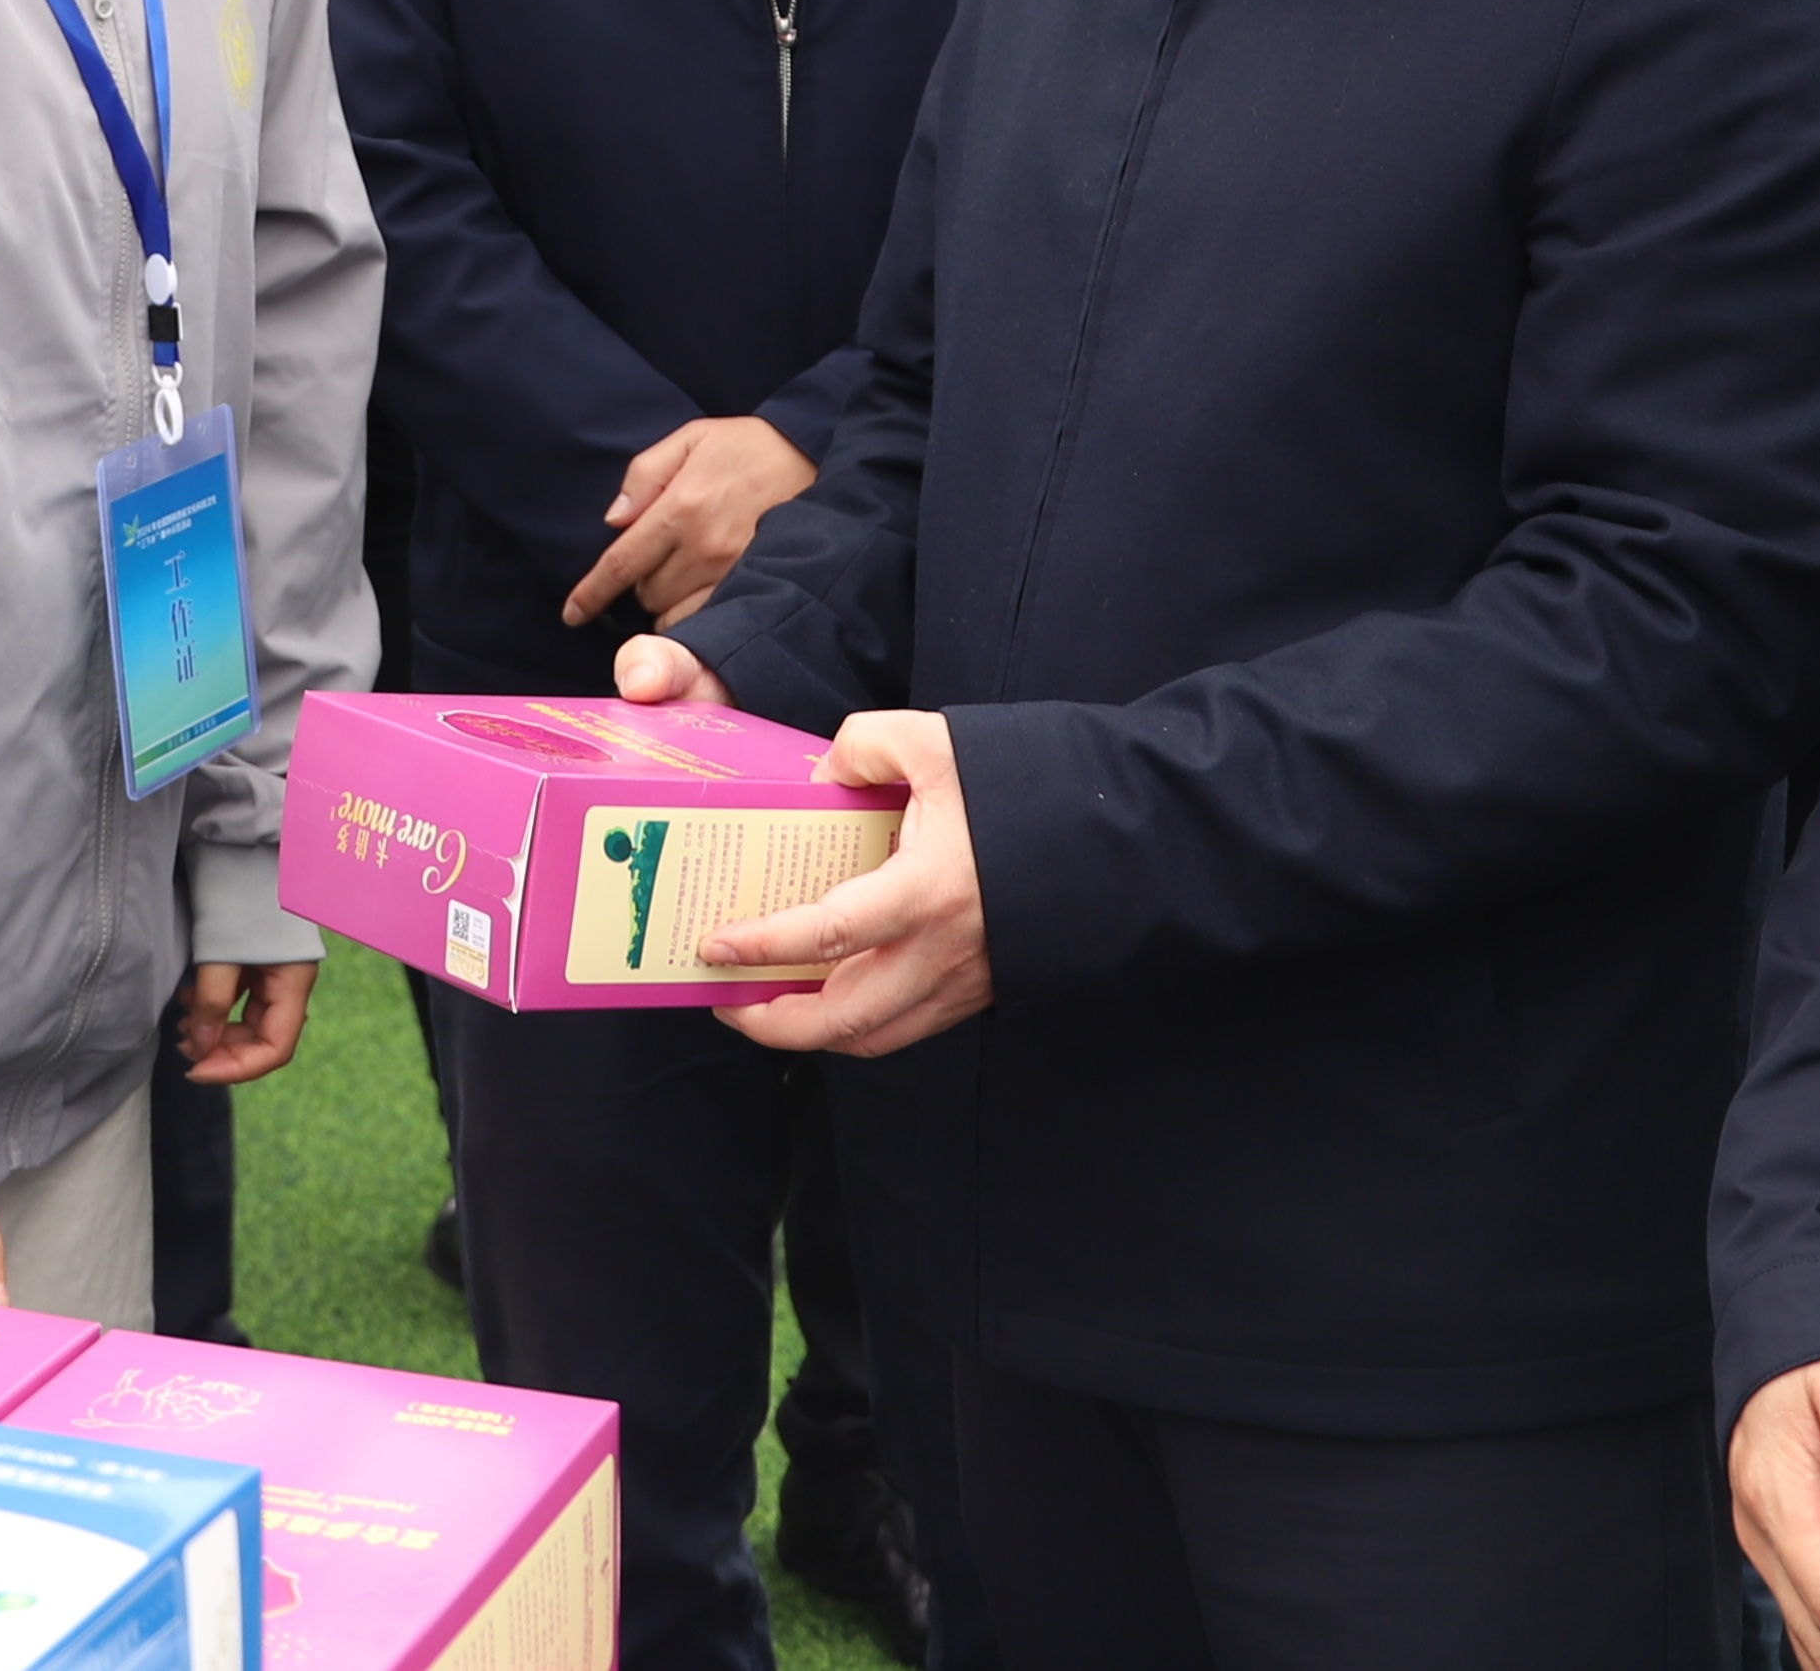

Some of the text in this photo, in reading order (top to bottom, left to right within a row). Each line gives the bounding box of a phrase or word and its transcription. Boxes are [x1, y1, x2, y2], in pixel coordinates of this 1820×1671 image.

[164, 549, 200, 685] 工作证
[335, 823, 390, 869] 卡倍多
[337, 790, 468, 895] Care more
